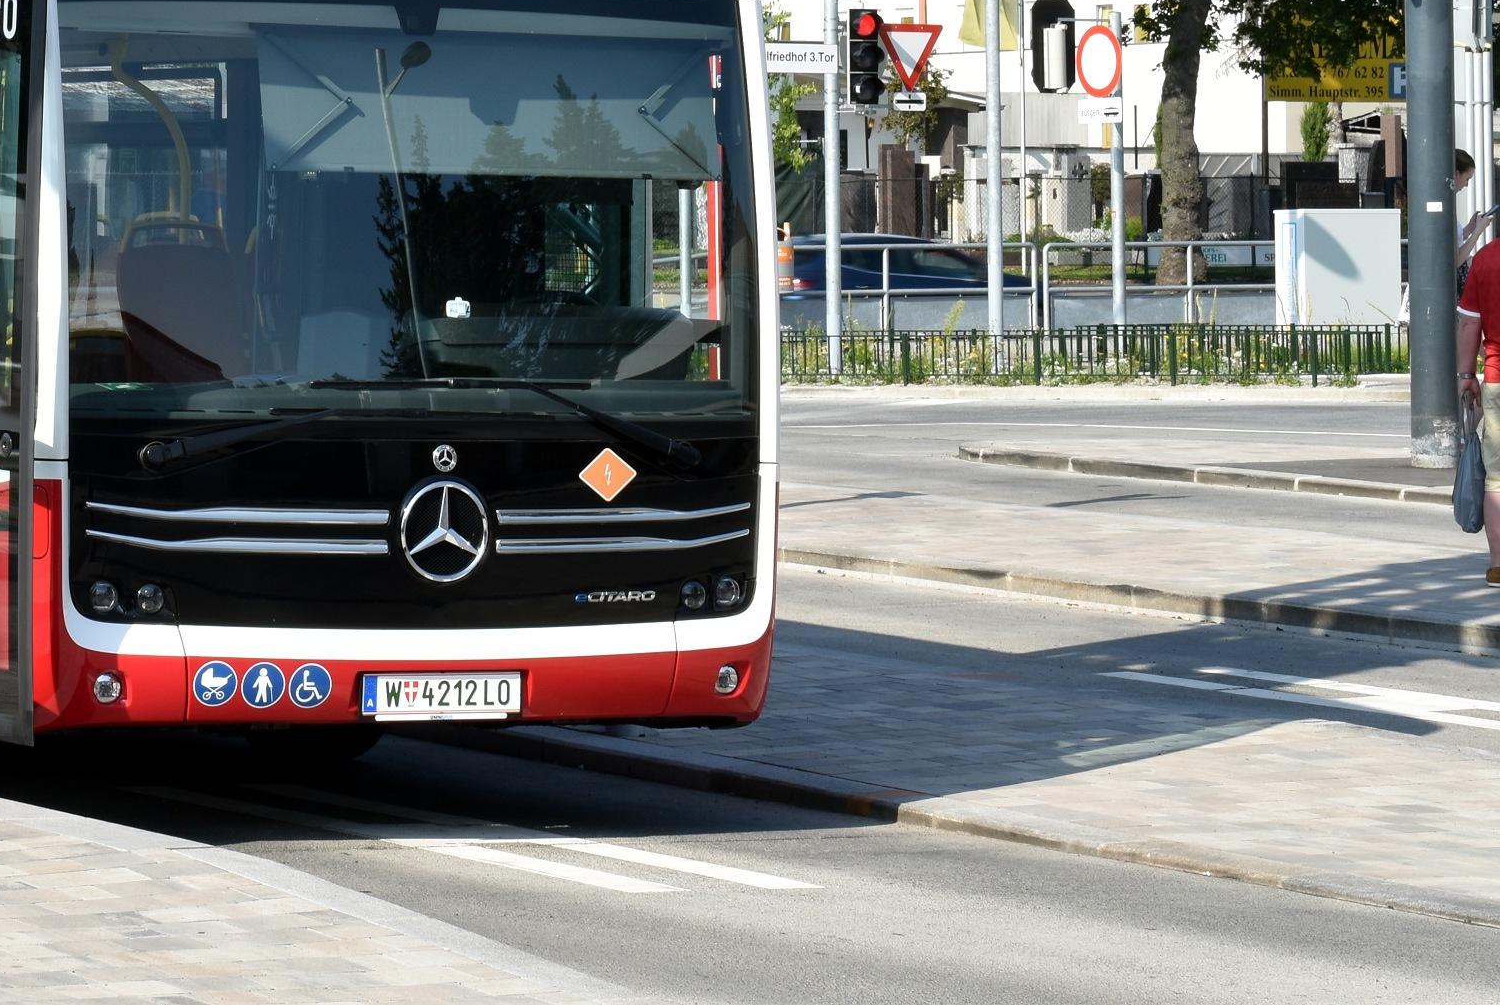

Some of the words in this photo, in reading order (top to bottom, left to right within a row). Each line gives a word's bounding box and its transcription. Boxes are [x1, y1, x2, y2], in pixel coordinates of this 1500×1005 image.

[1355, 66, 1367, 79] 62
[1371, 66, 1384, 79] 82
[1269, 86, 1305, 98] Simm.
[1309, 85, 1361, 100] Hauptstr.
[1365, 86, 1384, 98] 395
[385, 680, 402, 708] W
[366, 698, 374, 707] A
